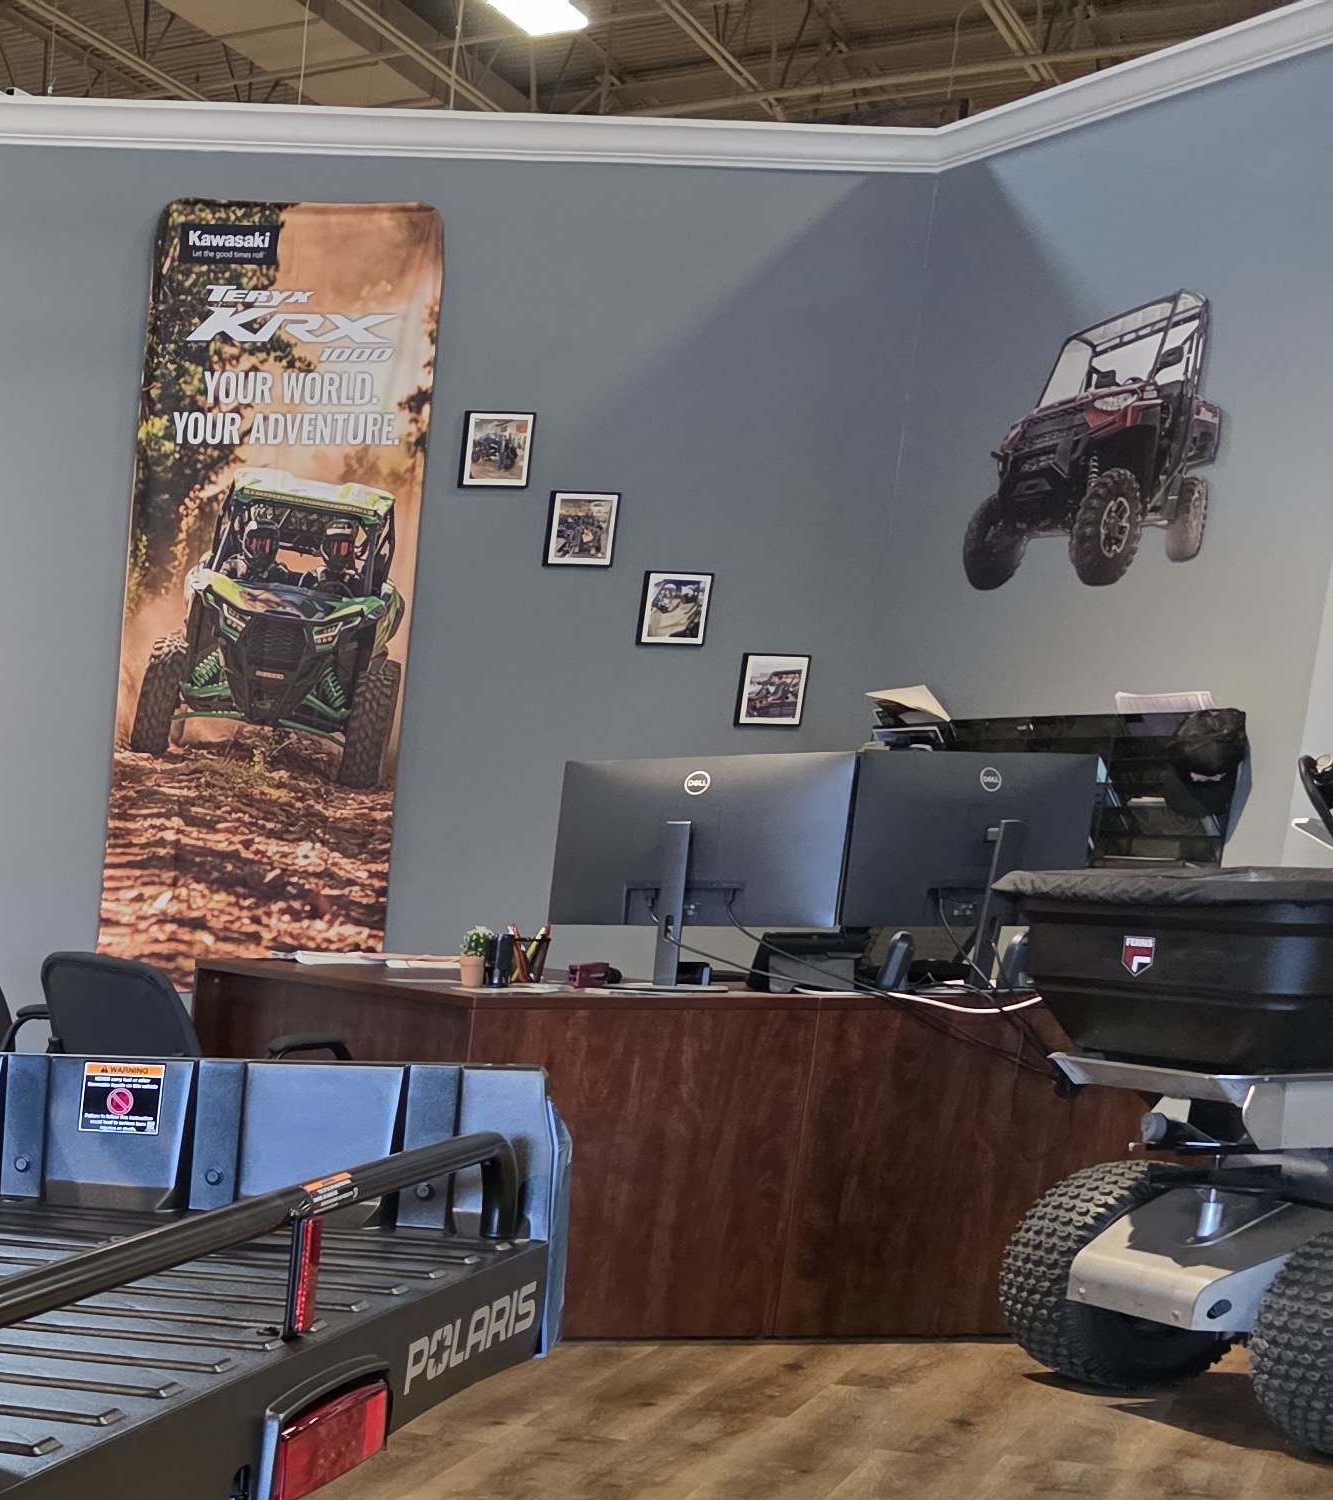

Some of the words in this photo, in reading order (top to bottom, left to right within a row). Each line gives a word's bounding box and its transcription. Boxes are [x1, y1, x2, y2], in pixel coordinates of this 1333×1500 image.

[188, 230, 271, 248] Kawasaki
[192, 249, 202, 257] Let
[215, 250, 233, 260] good
[186, 306, 399, 343] KRX
[320, 347, 393, 363] 1000
[204, 371, 273, 405] YOUR
[283, 372, 379, 406] WORLD.
[173, 411, 242, 446] YOUR
[249, 412, 401, 446] ADVENTURE.
[110, 1066, 149, 1075] WARNING
[403, 1280, 537, 1396] POLARIS
